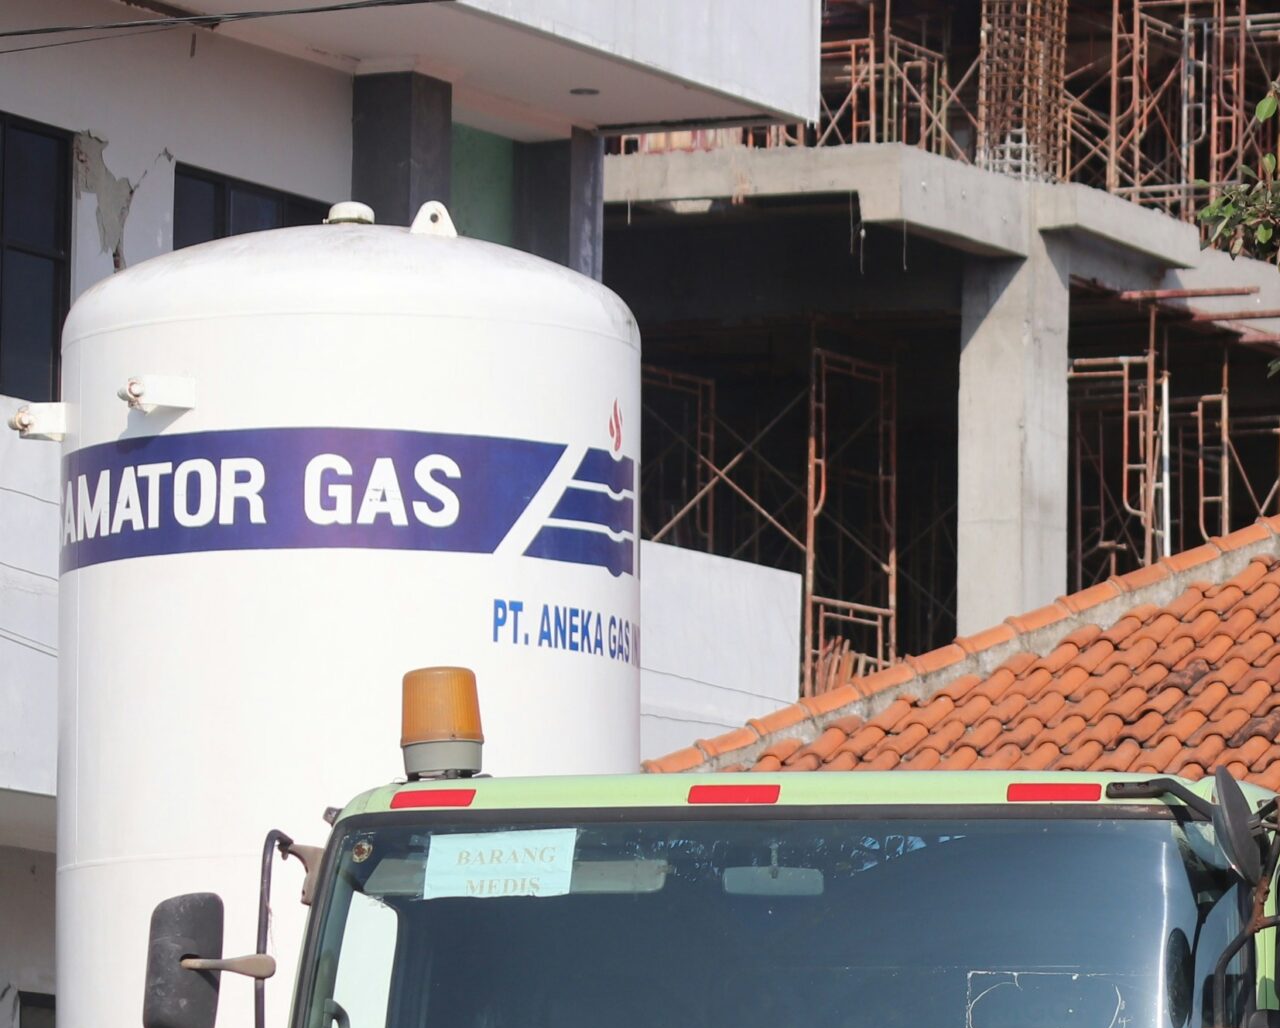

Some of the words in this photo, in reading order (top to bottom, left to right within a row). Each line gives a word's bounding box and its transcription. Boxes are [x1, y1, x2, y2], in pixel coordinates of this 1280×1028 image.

[60, 457, 267, 547] AMATOR
[304, 453, 461, 528] GAS
[493, 598, 529, 646] PT.
[538, 604, 604, 657] ANEKA
[608, 615, 630, 663] GAS
[456, 846, 557, 866] BARANG
[466, 876, 540, 896] MEDIS
